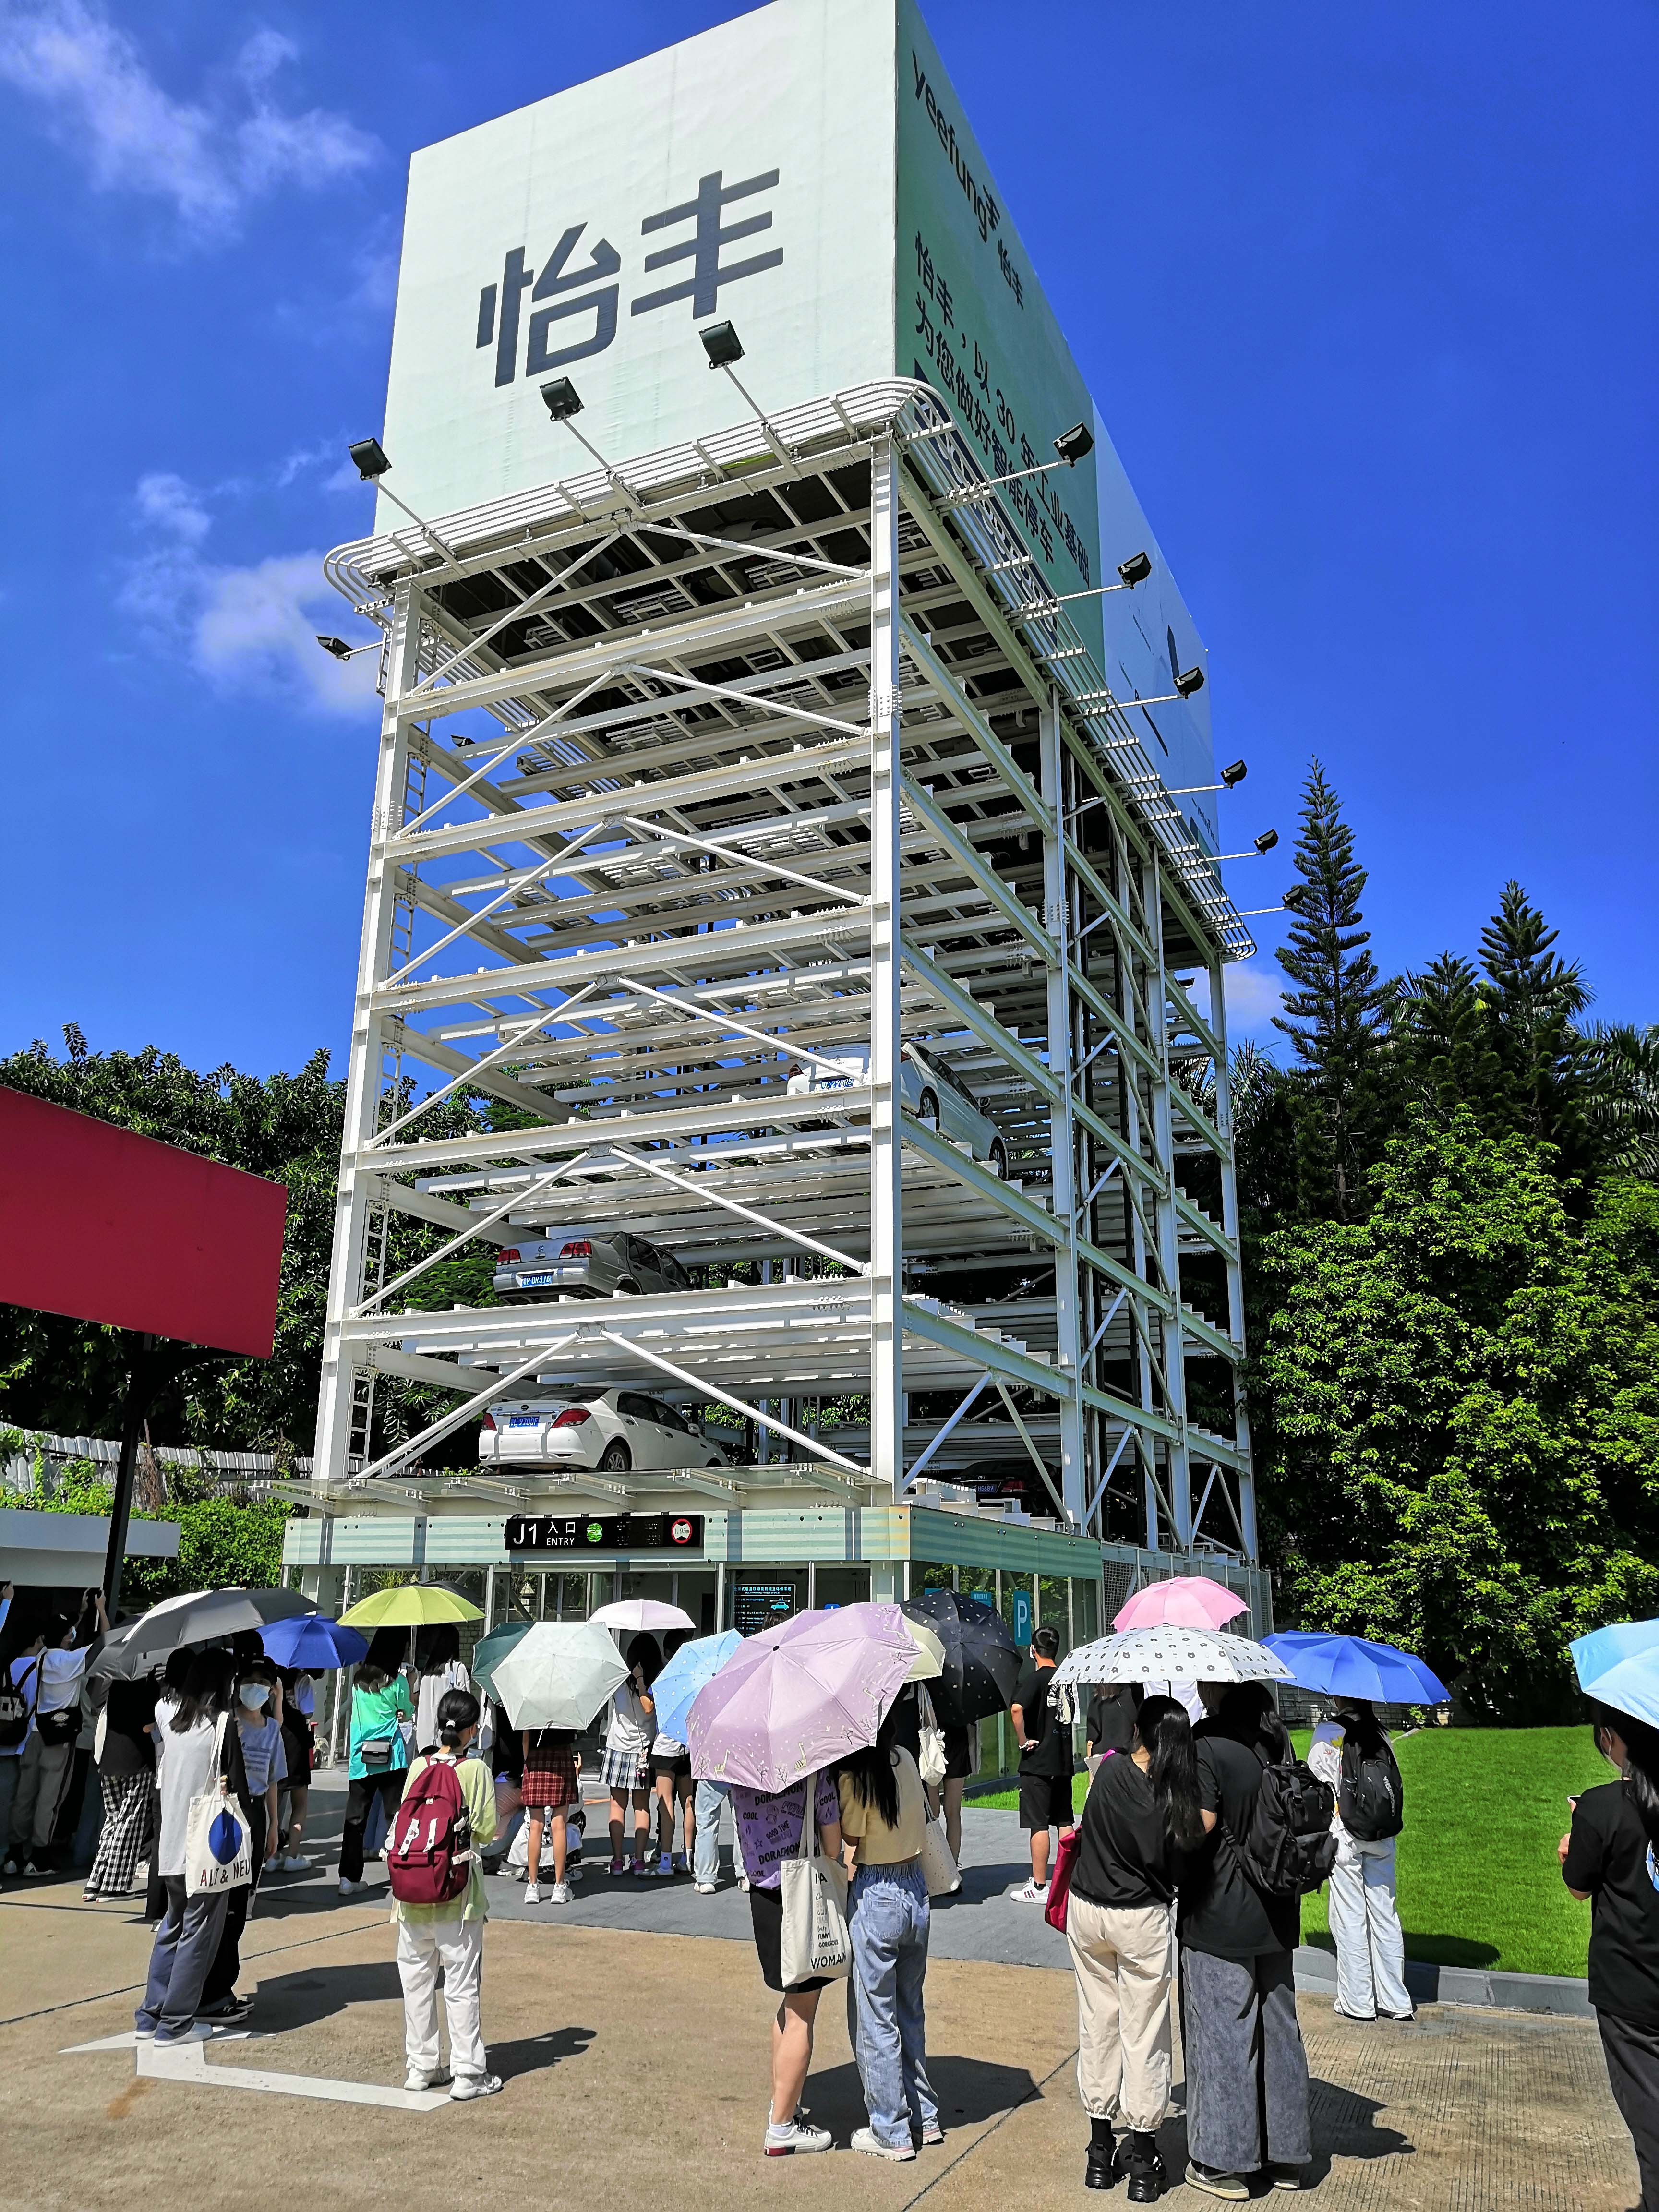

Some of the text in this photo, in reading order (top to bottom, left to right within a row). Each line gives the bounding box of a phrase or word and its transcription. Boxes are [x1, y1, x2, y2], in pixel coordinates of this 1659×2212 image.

[476, 168, 783, 388] 怡丰
[998, 238, 1023, 310] 怡丰
[915, 291, 1053, 564] 为您做好智能停车
[513, 1523, 537, 1544] J1
[547, 1521, 576, 1534] 入口
[547, 1538, 575, 1546] ENTRY
[1018, 1599, 1028, 1638] P
[819, 1791, 836, 1806] COOL
[743, 1812, 759, 1821] COOL
[200, 1857, 251, 1887] ALT & NEU
[811, 1952, 846, 1970] WOMAN
